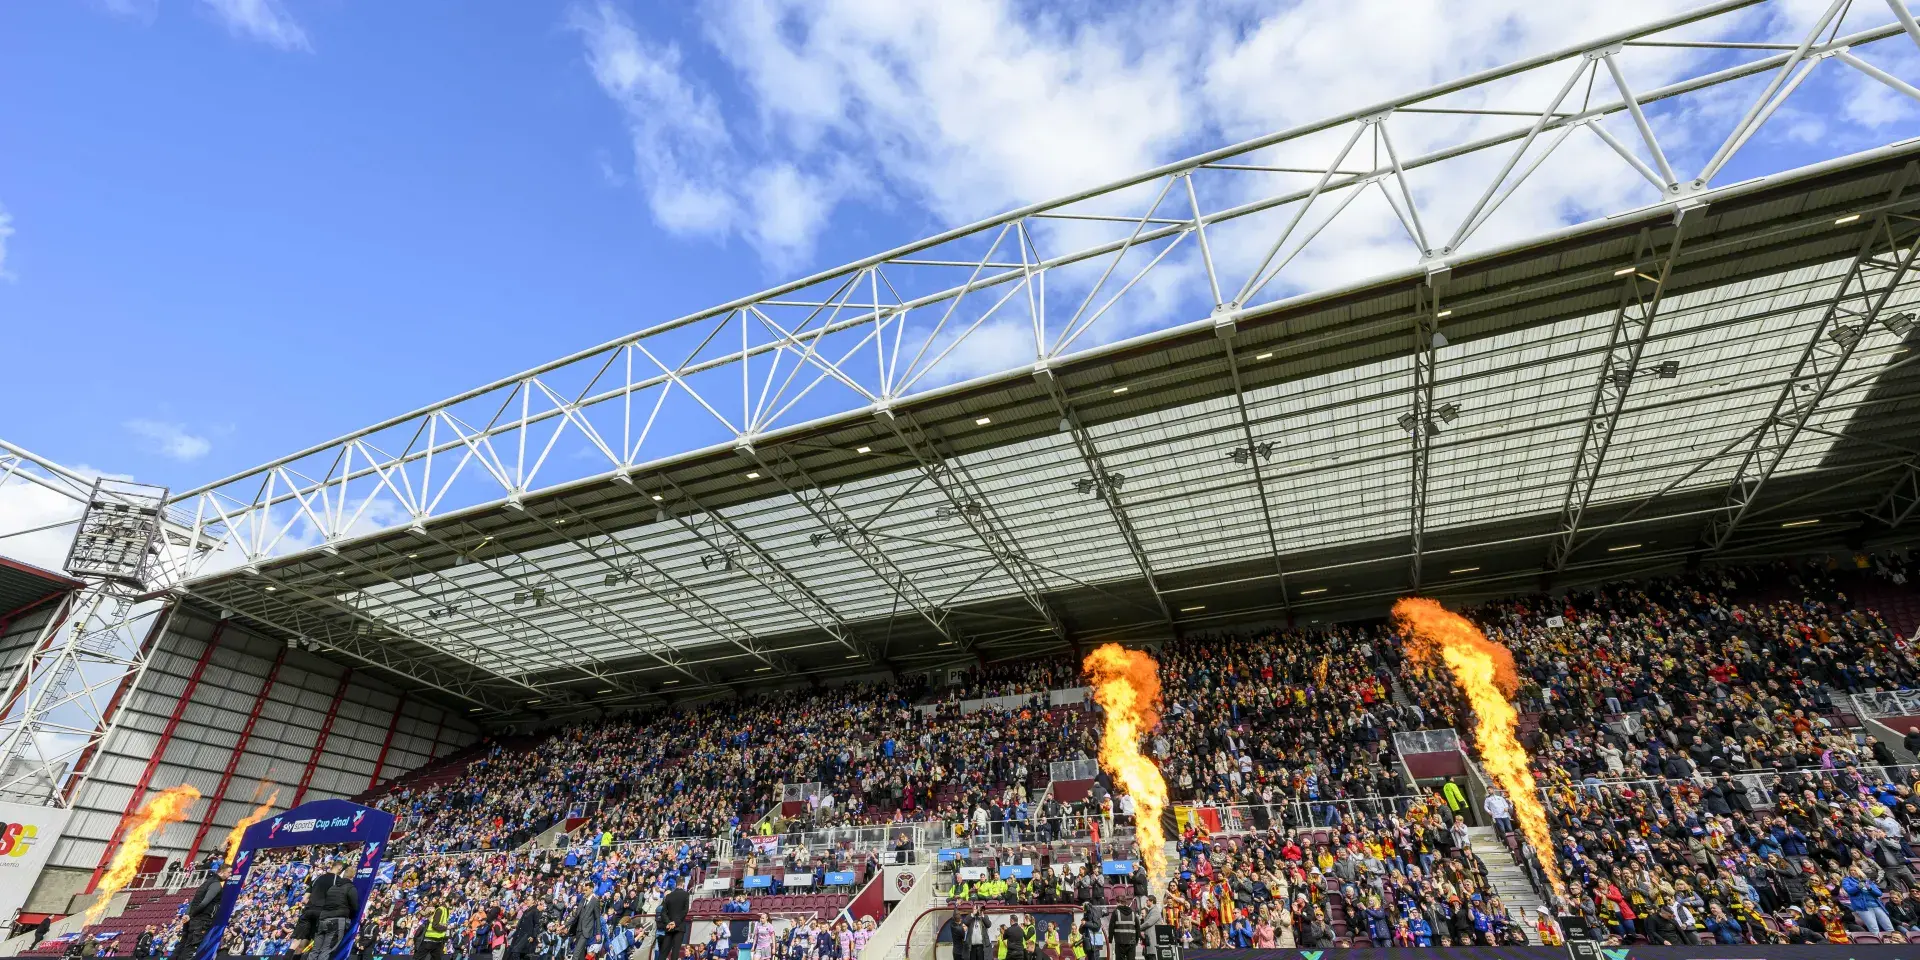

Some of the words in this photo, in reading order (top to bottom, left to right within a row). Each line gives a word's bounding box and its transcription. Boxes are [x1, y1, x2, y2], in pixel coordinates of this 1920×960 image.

[282, 822, 293, 833] sky
[293, 820, 315, 831] sports
[315, 819, 330, 830] Cup
[331, 816, 350, 828] Final
